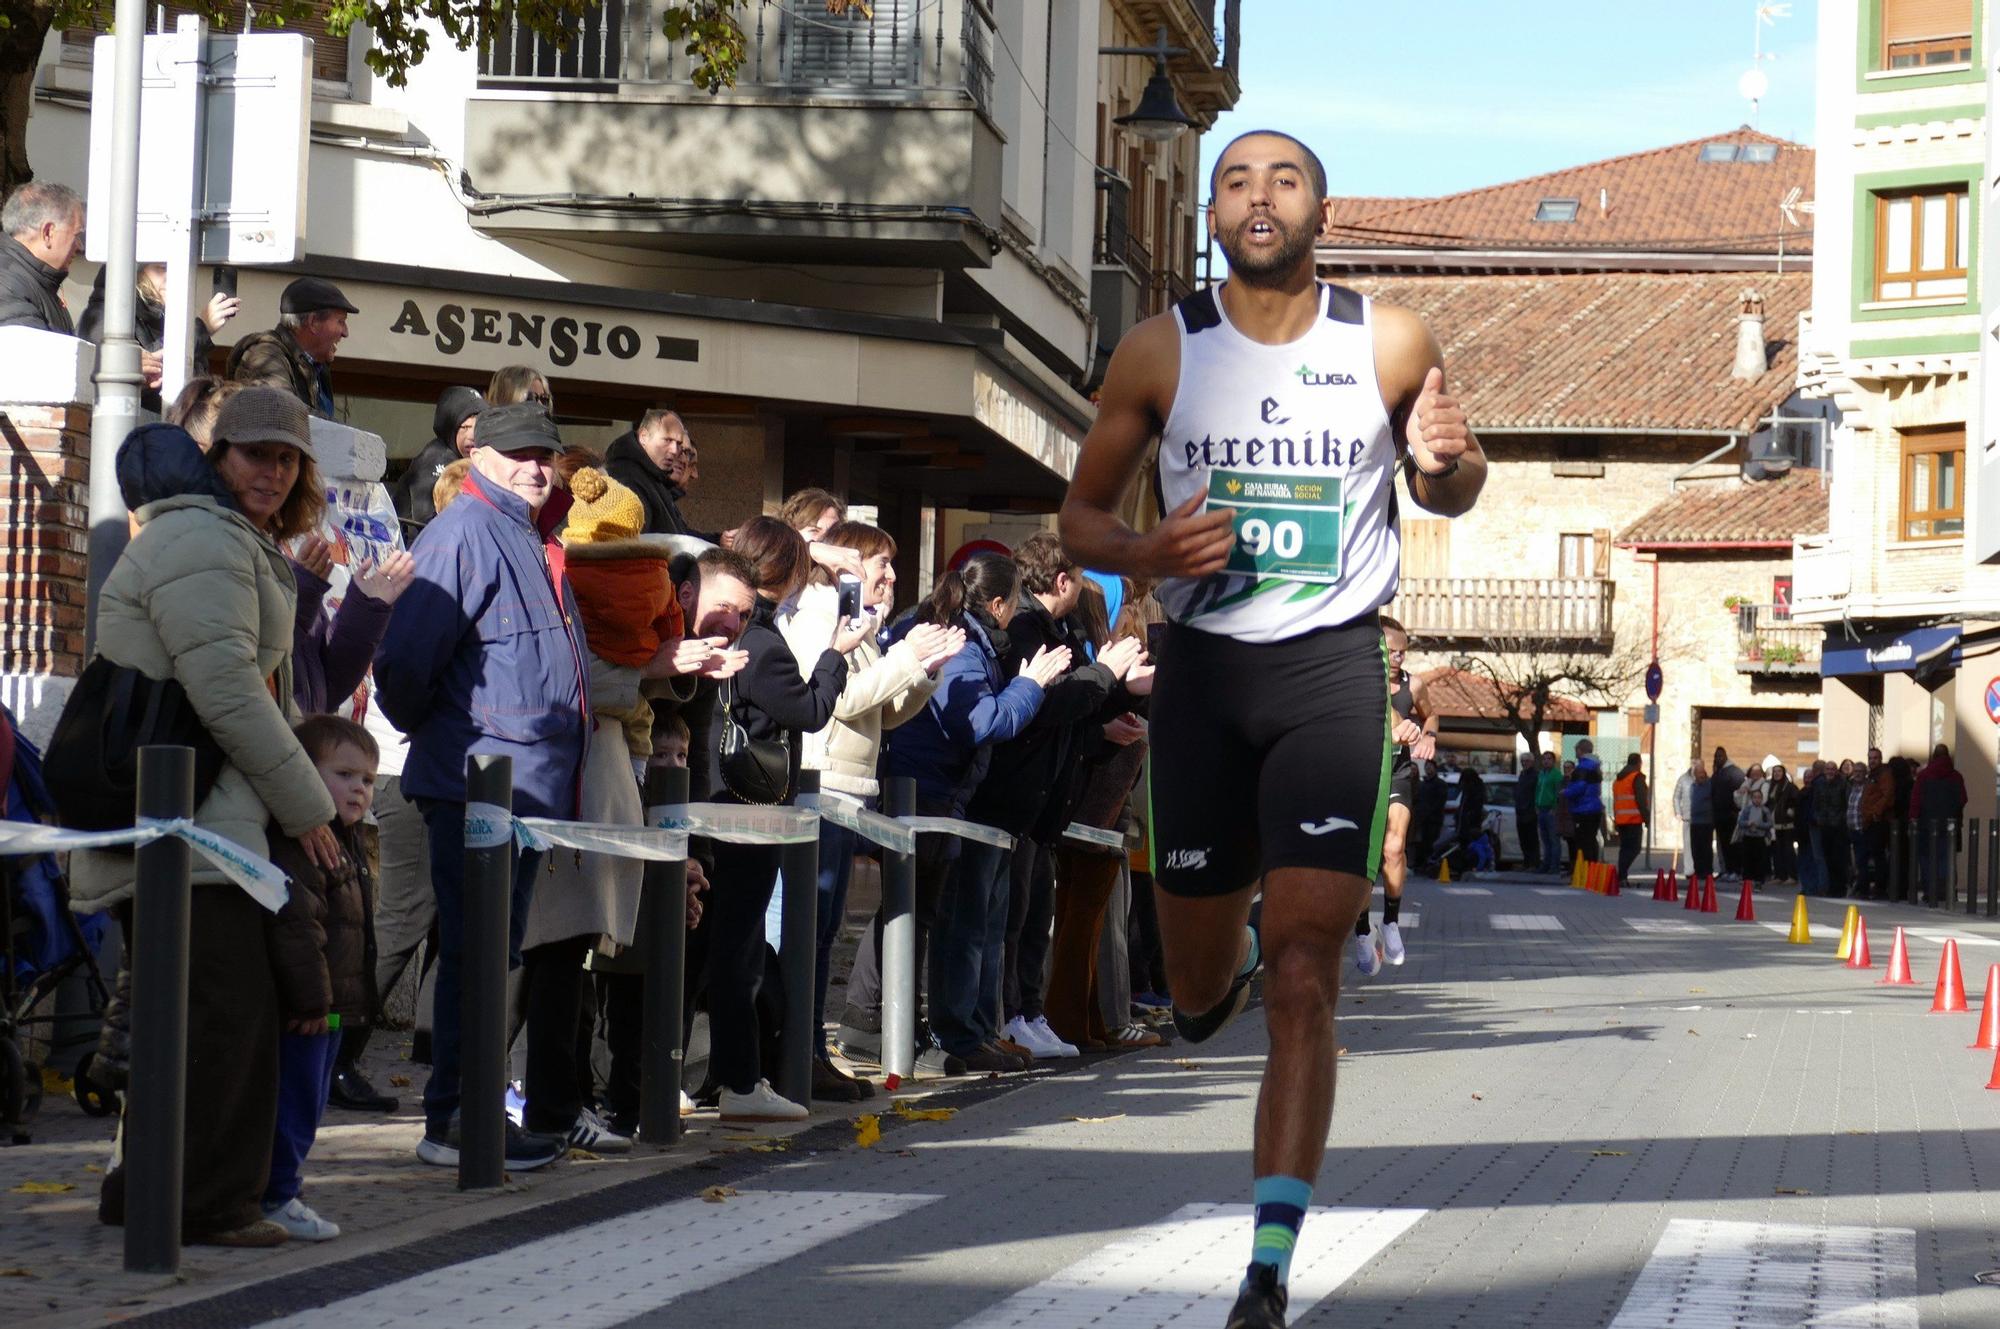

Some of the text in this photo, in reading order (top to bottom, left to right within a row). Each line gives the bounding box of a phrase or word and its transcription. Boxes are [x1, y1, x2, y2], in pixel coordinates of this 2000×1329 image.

[390, 299, 641, 367] ASENSIO
[1302, 373, 1358, 386] LUGA
[1184, 429, 1366, 469] etxenike
[1244, 482, 1288, 491] CAJA RURAL
[1256, 489, 1292, 499] NAVARRA
[1294, 492, 1321, 500] SOCIAL
[1240, 518, 1304, 559] 90
